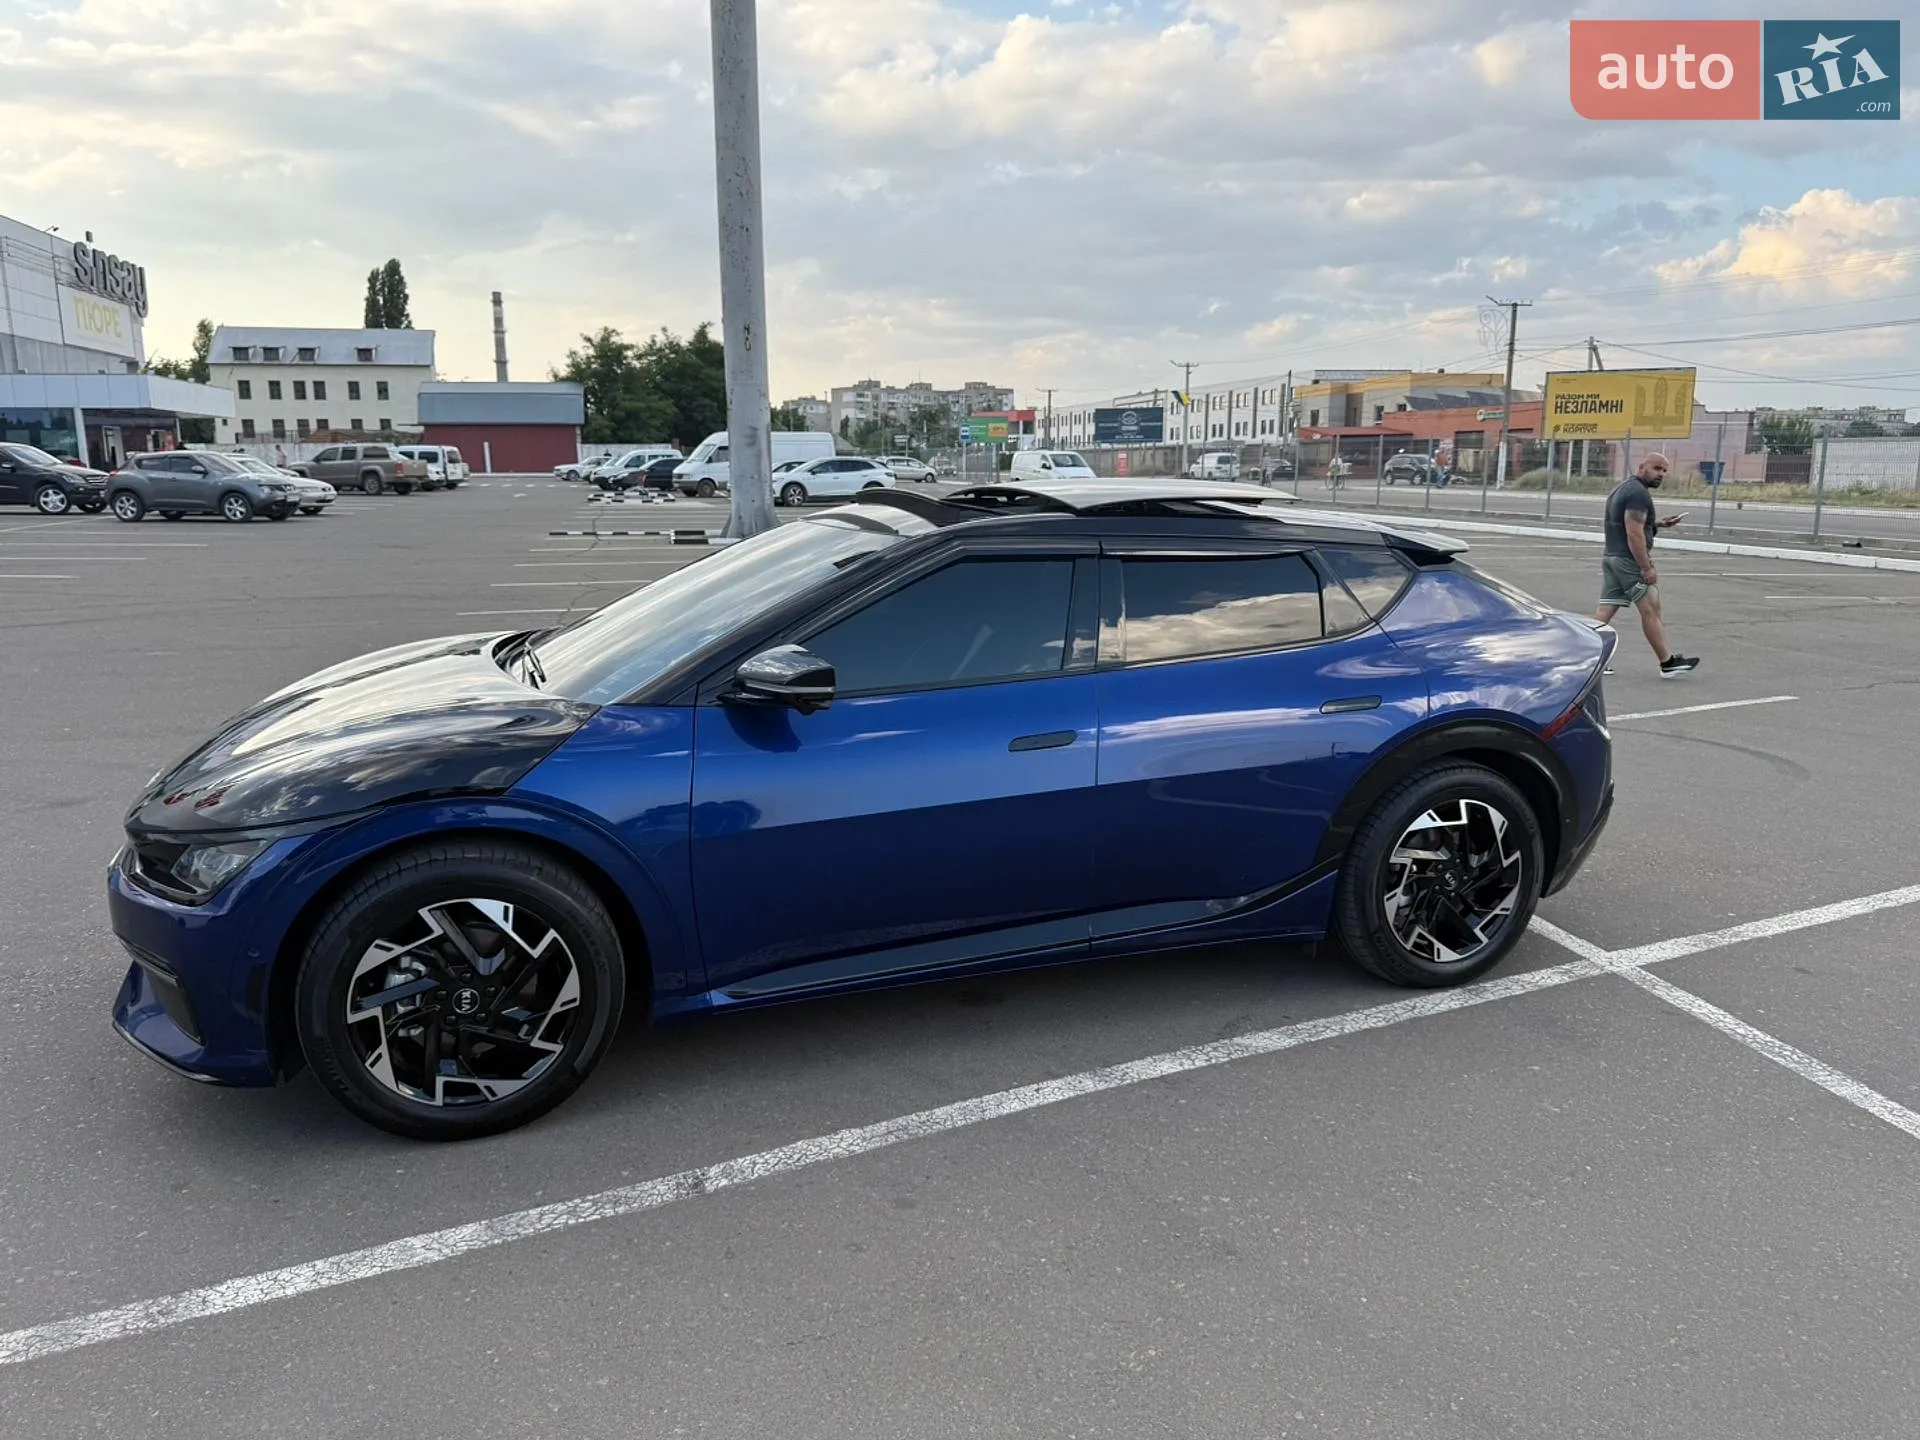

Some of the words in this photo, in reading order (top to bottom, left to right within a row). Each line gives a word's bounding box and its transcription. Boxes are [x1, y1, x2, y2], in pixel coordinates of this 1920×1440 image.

[73, 231, 149, 318] sinsay
[73, 296, 122, 338] ПЮРЕ
[1554, 399, 1624, 415] НЕЗЛАМНІ
